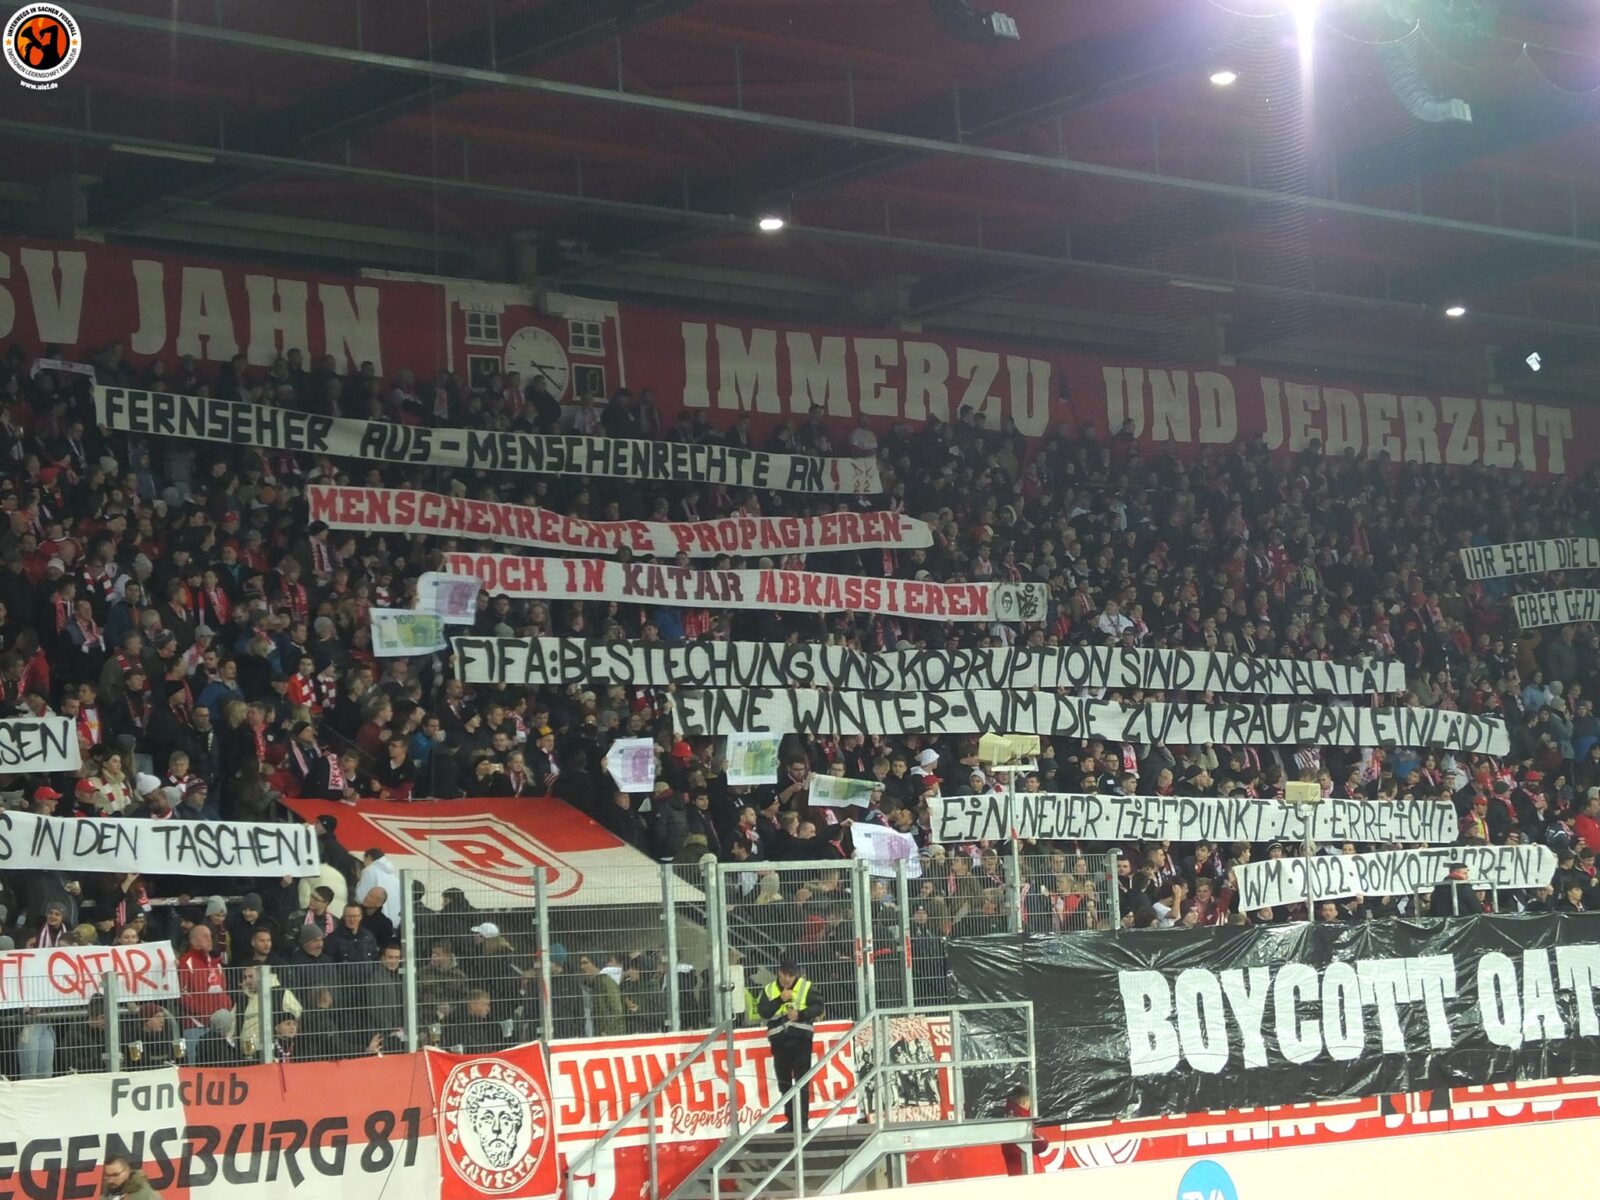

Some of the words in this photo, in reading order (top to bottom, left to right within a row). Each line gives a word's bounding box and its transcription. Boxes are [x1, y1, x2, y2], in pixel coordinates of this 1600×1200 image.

[131, 259, 383, 377] JAHN
[681, 321, 1051, 437] IMMERZU
[1102, 366, 1238, 444] UND
[1260, 376, 1574, 475] JEDERZEIT
[105, 388, 334, 452] FERNSEHER
[359, 422, 434, 462] AUS
[465, 430, 769, 487] MENSCHENRECHTE
[309, 487, 655, 551] MENSCHENRECHTE
[451, 554, 548, 592] DOCH
[563, 558, 605, 593] IN
[622, 562, 744, 601] KATAR
[756, 569, 989, 616] ABKASSIEREN
[1465, 547, 1497, 579] IHR
[1501, 541, 1547, 574] SEHT
[1554, 538, 1580, 569] DIE
[1517, 592, 1560, 627] ABER
[820, 643, 895, 691] UND
[897, 646, 1113, 691] KORRUPTION
[1120, 650, 1196, 690] SIND
[677, 689, 773, 735] EINE
[1052, 693, 1109, 739] DIE
[1121, 701, 1193, 744] ZUM
[1206, 702, 1360, 745] TRAUERN
[31, 816, 65, 861] IN
[73, 819, 138, 860] DEN
[151, 823, 314, 868] TASCHEN!
[1243, 860, 1282, 907] WM
[1292, 855, 1351, 898] 2022
[48, 948, 170, 998] QATAR!
[1118, 953, 1456, 1077] BOYCOTT
[110, 1072, 249, 1118] Fanclub
[558, 1039, 855, 1125] JAHNGSTRS
[359, 1106, 421, 1174] 81
